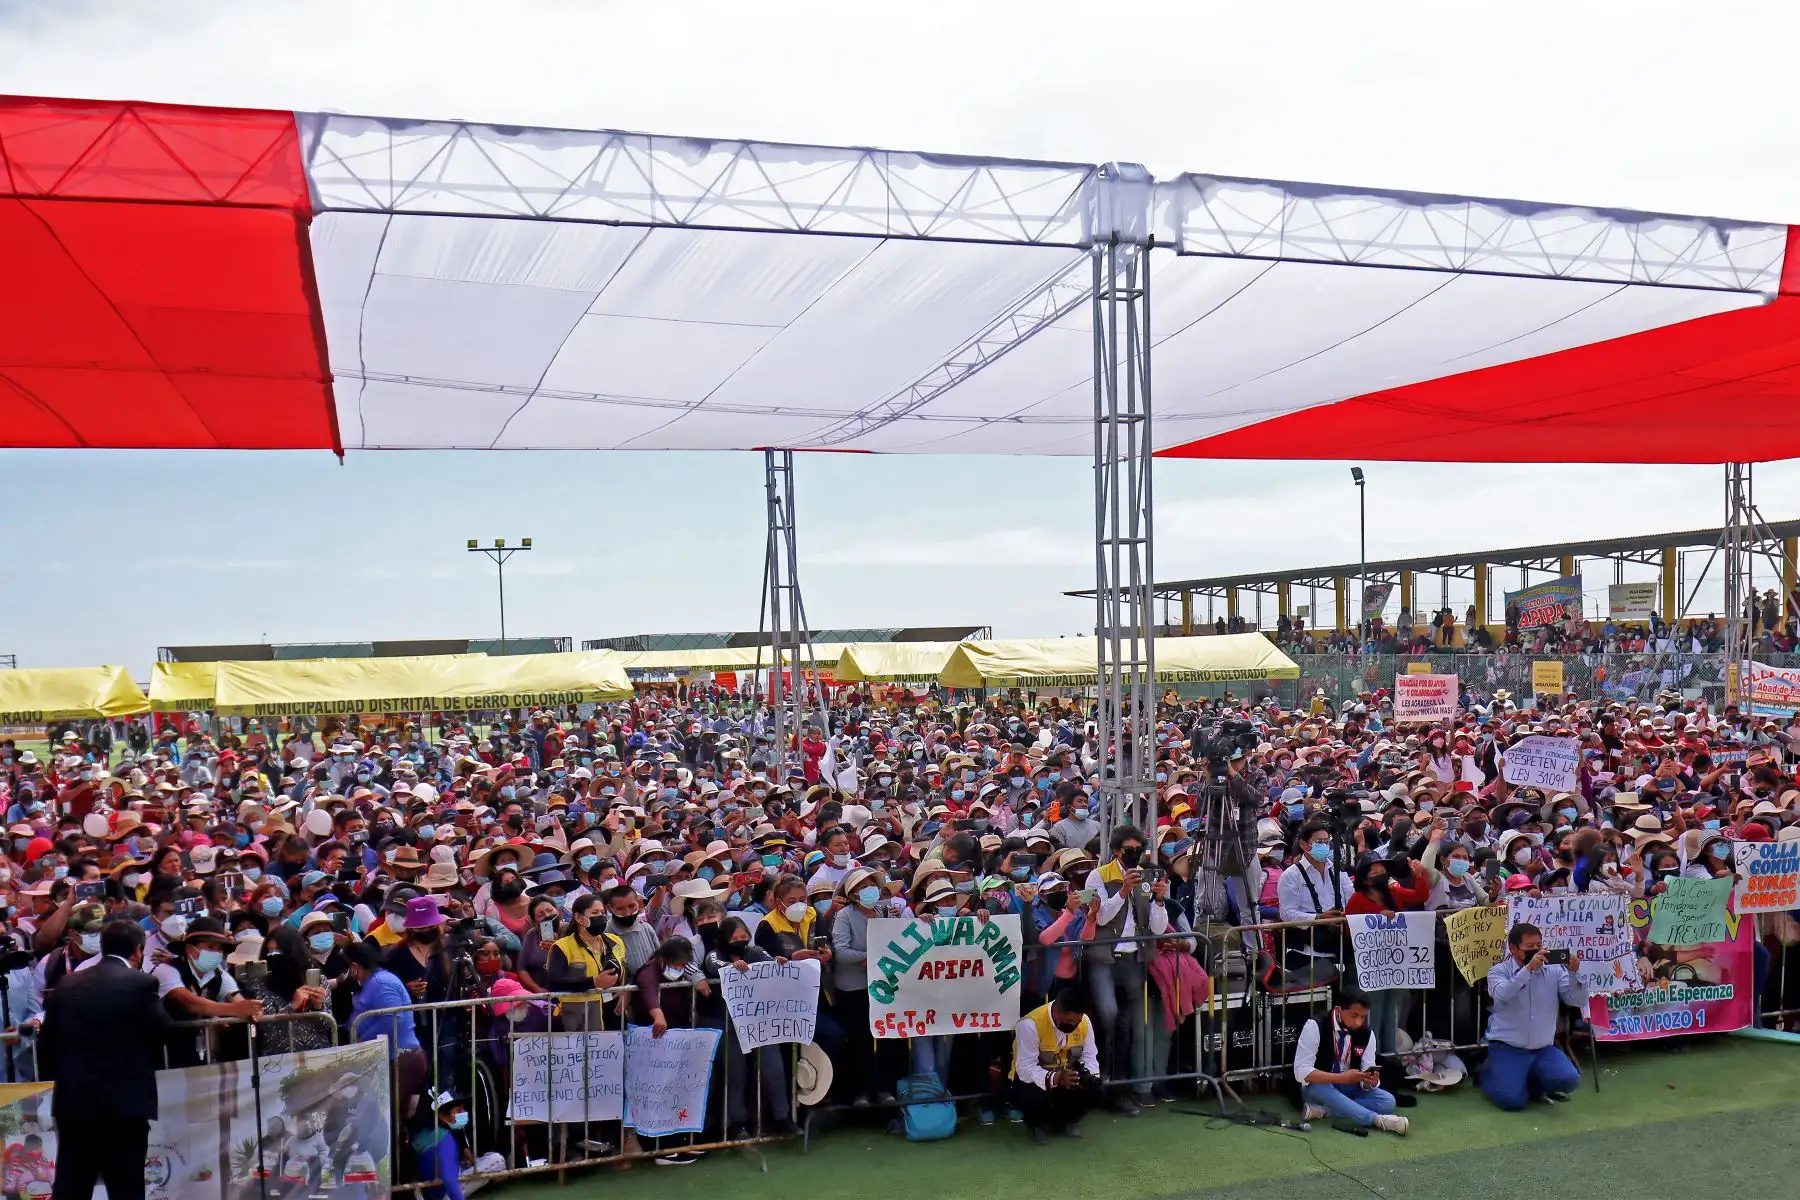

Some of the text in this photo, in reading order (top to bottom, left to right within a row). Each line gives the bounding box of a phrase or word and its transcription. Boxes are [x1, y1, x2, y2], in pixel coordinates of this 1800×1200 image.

[1517, 603, 1565, 628] APIPA
[894, 673, 938, 682] MUNICIPA
[1160, 671, 1173, 682] DE
[1176, 670, 1210, 682] CERRO
[1214, 668, 1268, 680] COLORADO
[1757, 683, 1777, 693] Abad
[1780, 685, 1789, 694] de
[176, 700, 214, 711] MUNIC
[255, 699, 364, 716] MUNICIPALIDAD
[369, 696, 438, 712] DISTRITAL
[444, 696, 461, 710] DE
[465, 694, 510, 709] CERRO
[513, 691, 584, 707] COLORADO
[1, 710, 43, 724] RADO
[1507, 752, 1575, 775] RESPETEN LA
[1511, 767, 1530, 781] LEY
[1760, 842, 1798, 859] OLLA
[1749, 857, 1800, 875] COMUN
[1365, 913, 1407, 930] OLLA
[1474, 921, 1492, 933] REY
[1545, 911, 1594, 925] CAPILLA
[1355, 930, 1408, 949] COMUN
[1539, 924, 1568, 938] ECTOR
[1358, 946, 1430, 969] GRUPO 32
[917, 958, 985, 981] APIPA
[1359, 967, 1435, 989] CRISTO REY
[1589, 973, 1614, 988] POYO
[727, 985, 755, 1002] CON
[1656, 986, 1666, 1003] la
[1669, 984, 1734, 1006] Esperanza
[732, 999, 813, 1019] ISCAPACID
[874, 1008, 1002, 1038] SECTOR VIII
[1608, 1008, 1705, 1035] CTOR V POZO 1
[737, 1018, 815, 1044] PRESENTE
[534, 1064, 605, 1085] ALCALDE
[577, 1082, 621, 1101] CORNE
